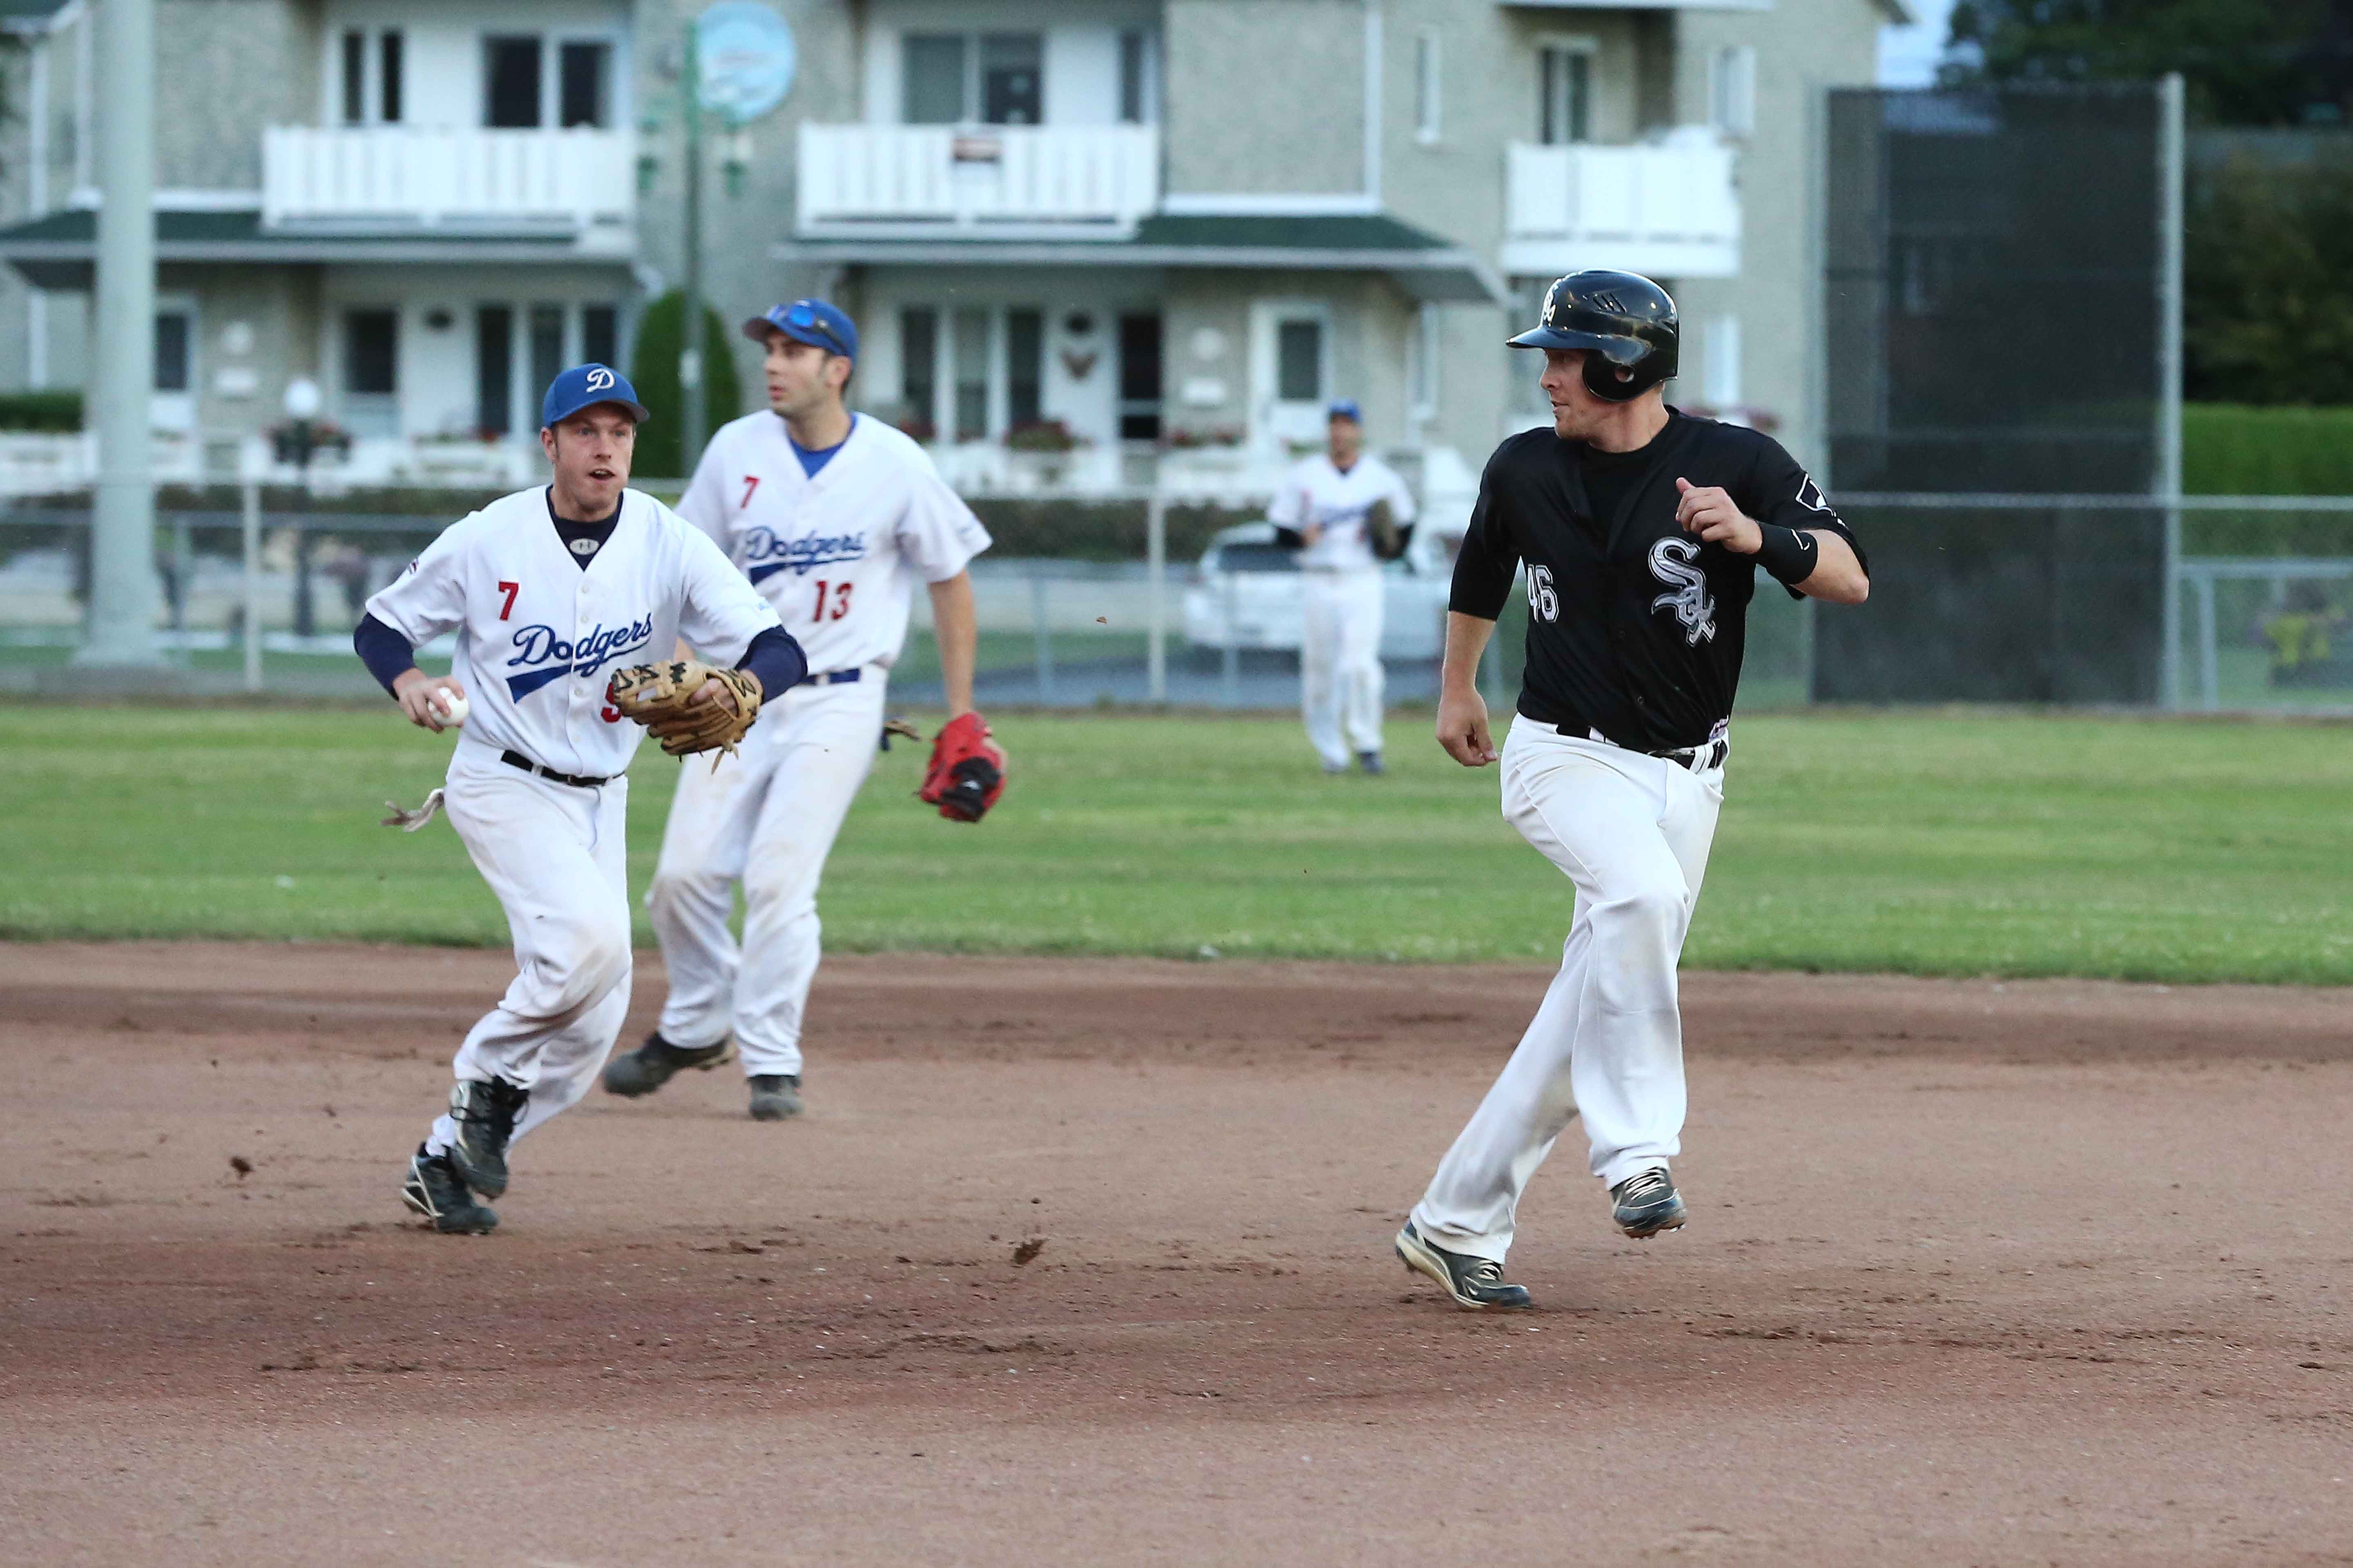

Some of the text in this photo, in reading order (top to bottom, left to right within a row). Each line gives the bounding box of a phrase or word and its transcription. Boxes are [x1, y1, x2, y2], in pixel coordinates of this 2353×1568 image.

[586, 368, 615, 393] D
[741, 476, 760, 509] 7
[744, 525, 864, 575] Dodgers
[498, 581, 519, 621] 7
[814, 580, 853, 621] 13
[1528, 564, 1559, 622] 46
[1648, 536, 1716, 647] Sox
[507, 613, 652, 677] Dodgers
